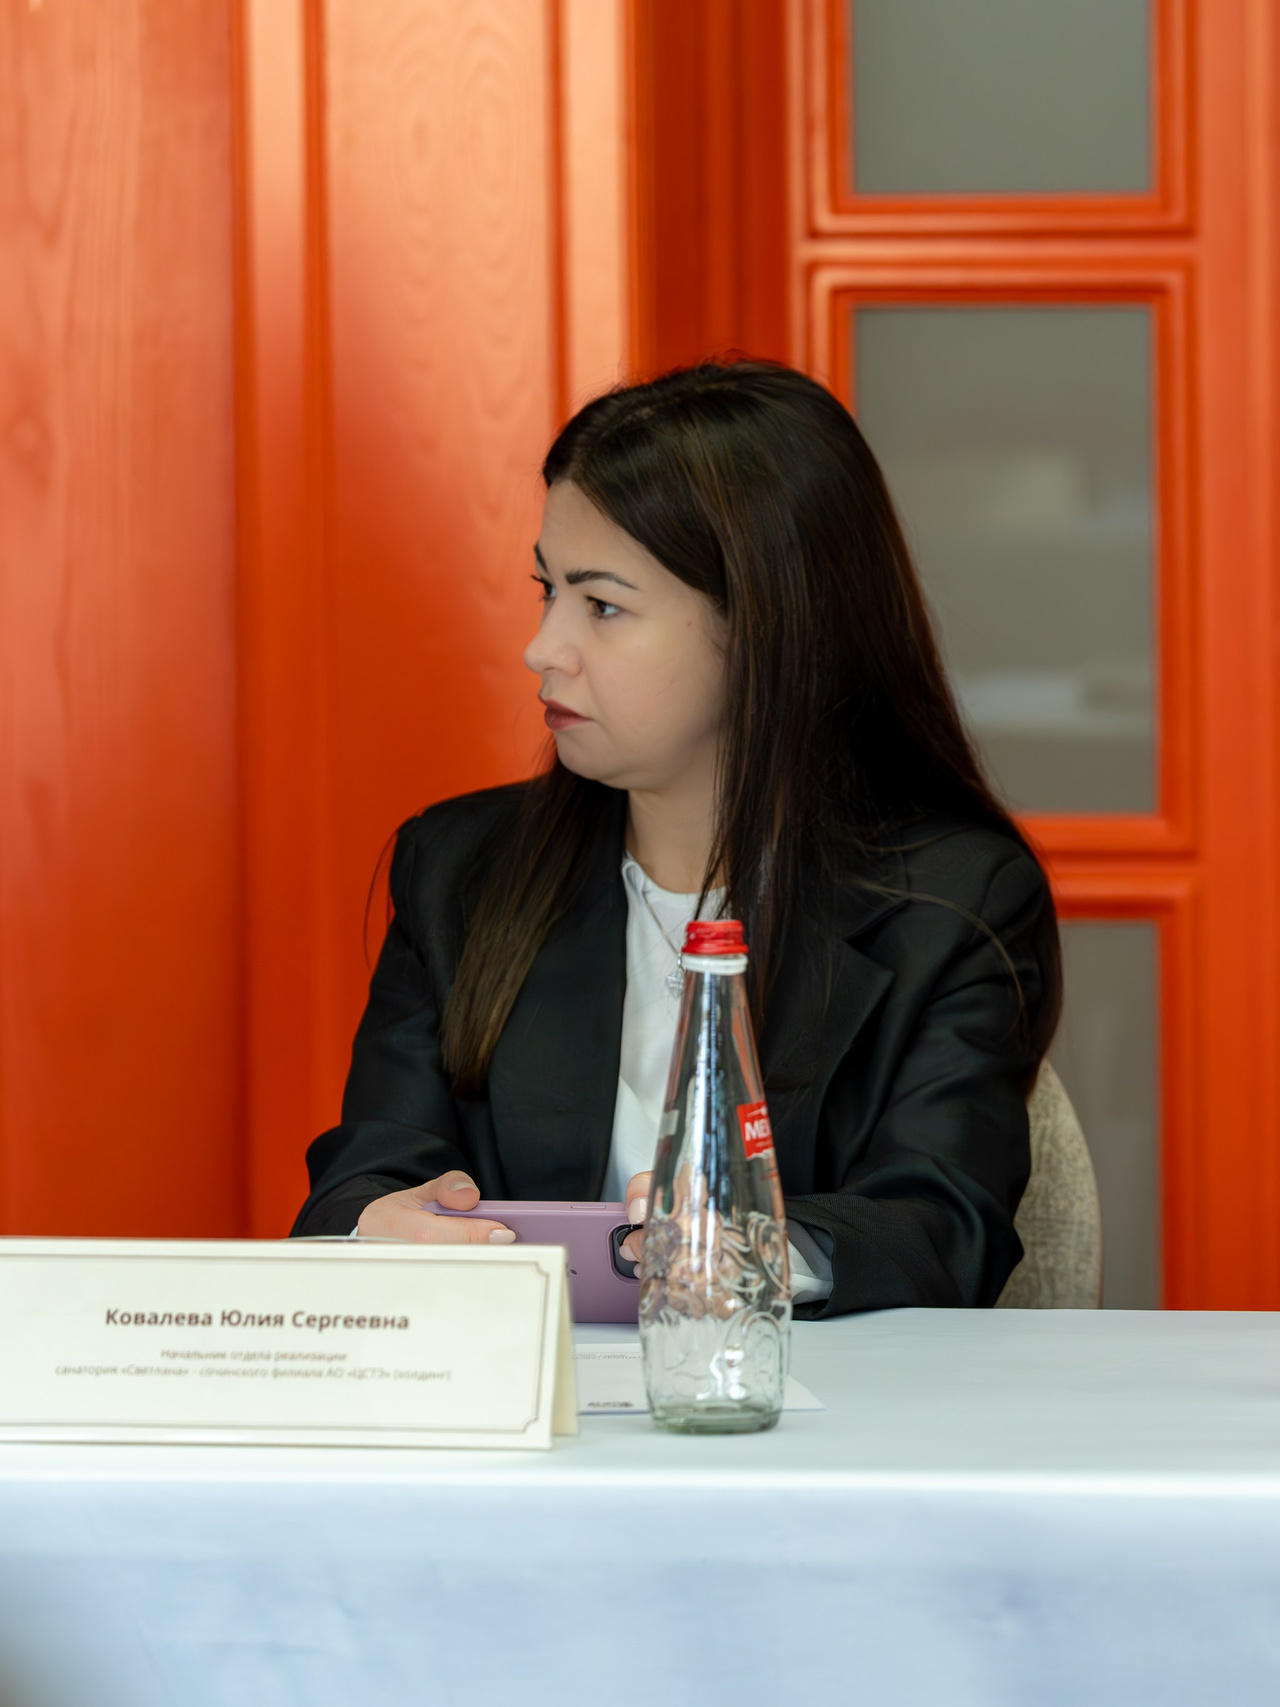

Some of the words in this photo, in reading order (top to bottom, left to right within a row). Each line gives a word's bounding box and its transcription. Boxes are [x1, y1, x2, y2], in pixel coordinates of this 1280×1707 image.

[105, 1308, 213, 1329] Ковалева
[220, 1309, 285, 1329] Юлия
[291, 1310, 411, 1333] Сергеевна
